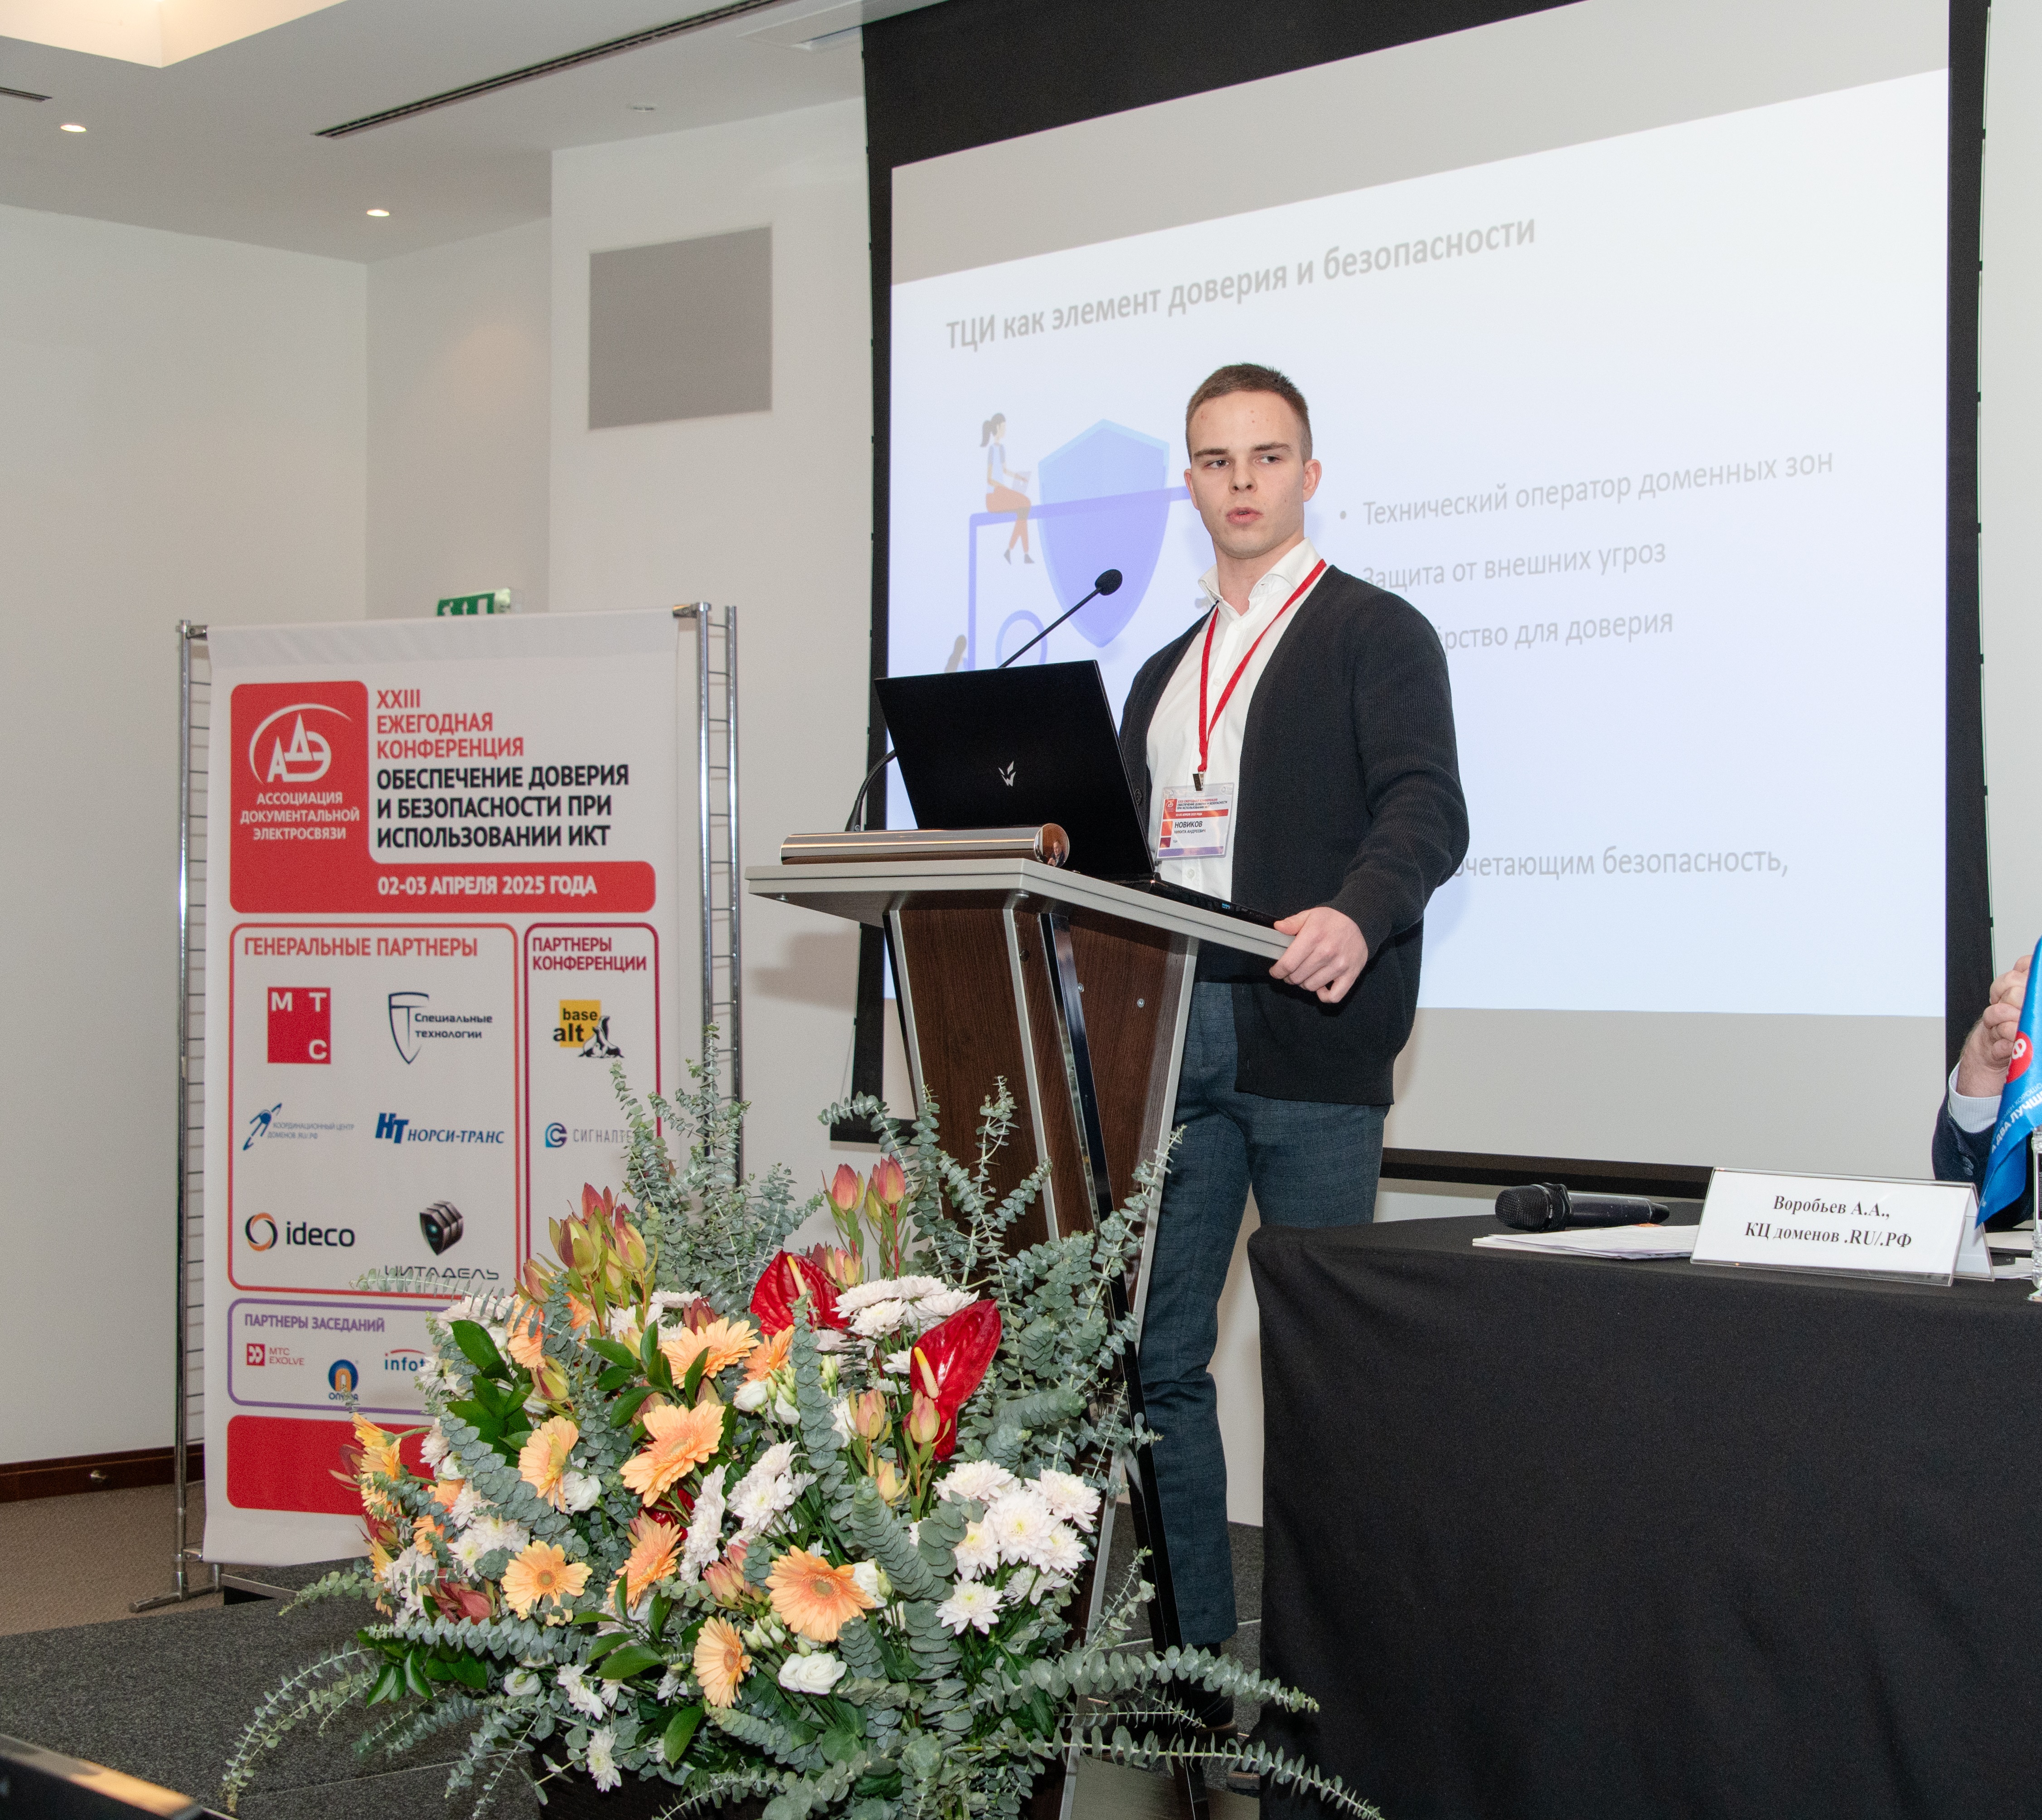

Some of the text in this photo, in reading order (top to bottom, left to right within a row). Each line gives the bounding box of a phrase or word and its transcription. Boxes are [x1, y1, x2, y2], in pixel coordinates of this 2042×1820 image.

[946, 219, 1535, 353] ТЦИ как элемент доверия и безопасности
[1363, 452, 1833, 525] Технический оператор доменных зон
[1363, 543, 1666, 592] Защита от внешних угроз
[1435, 613, 1673, 658] рство для доверия
[377, 689, 420, 709] XXIII
[377, 713, 493, 735] ЕЖЕГОДНАЯ
[377, 737, 524, 760] КОНФЕРЕНЦИЯ
[377, 765, 629, 790] ОБЕСПЕЧЕНИЕ ДОВЕРИЯ
[257, 791, 343, 806] АССОЦИАЦИЯ
[378, 796, 612, 819] И БЕЗОПАСНОСТИ ПРИ
[240, 807, 360, 825] ДОКУМЕНТАЛЬНОЙ
[253, 827, 346, 840] ЭЛЕКТРОСВЯЗИ
[378, 825, 611, 848] ИСПОЛЬЗОВАНИИ ИКТ
[1602, 845, 1788, 878] безопасность,
[378, 876, 597, 896] 02-03 АПРЕЛЯ 2025 ГОДА
[245, 937, 478, 956] ГЕНЕРАЛЬНЫЕ ПАРТНЕРЫ
[532, 937, 612, 952] ПАРТНЕРЫ
[533, 956, 647, 972] КОНФЕРЕНЦИИ
[415, 1013, 493, 1023] Специальные
[563, 1008, 598, 1021] base
[415, 1030, 482, 1039] технологии
[553, 1024, 584, 1043] alt
[2010, 1090, 2042, 1123] ЛУЧШ
[408, 1129, 504, 1144] НОРСИ-ТРАНС
[573, 1129, 633, 1143] СИГНАЛТЕ
[1773, 1195, 1890, 1220] Воробьев А.А.,
[286, 1221, 355, 1247] ideco
[1745, 1222, 1911, 1248] КЦ доменов .RU/.РФ
[385, 1265, 499, 1280] ЦИТАДЕЛЬ
[245, 1314, 385, 1333] ПАРТНЕРЫ ЗАСЕДАНИЙ
[269, 1357, 304, 1365] EXOLVE
[385, 1353, 425, 1371] infot
